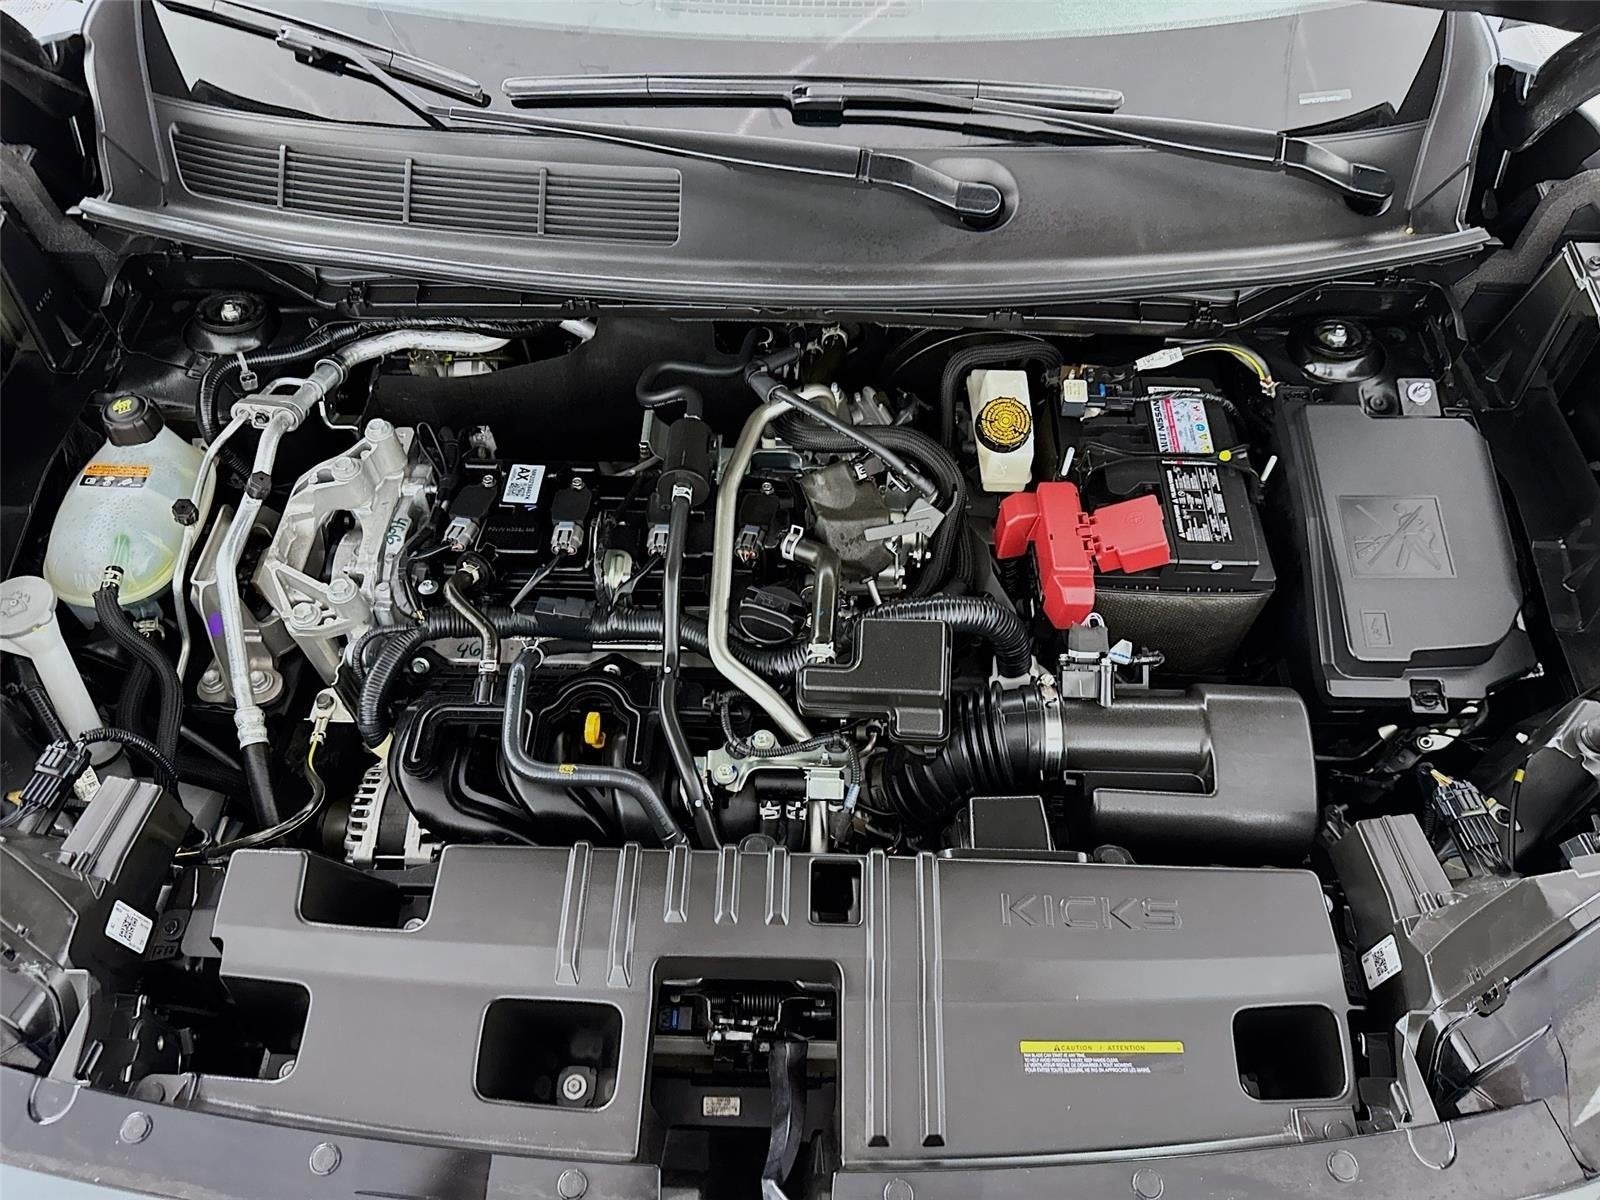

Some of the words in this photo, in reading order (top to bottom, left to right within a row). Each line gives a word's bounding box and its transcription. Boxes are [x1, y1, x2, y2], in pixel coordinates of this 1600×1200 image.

[1153, 399, 1165, 431] NISSAN
[516, 467, 531, 480] AX
[1000, 893, 1183, 931] KICKS
